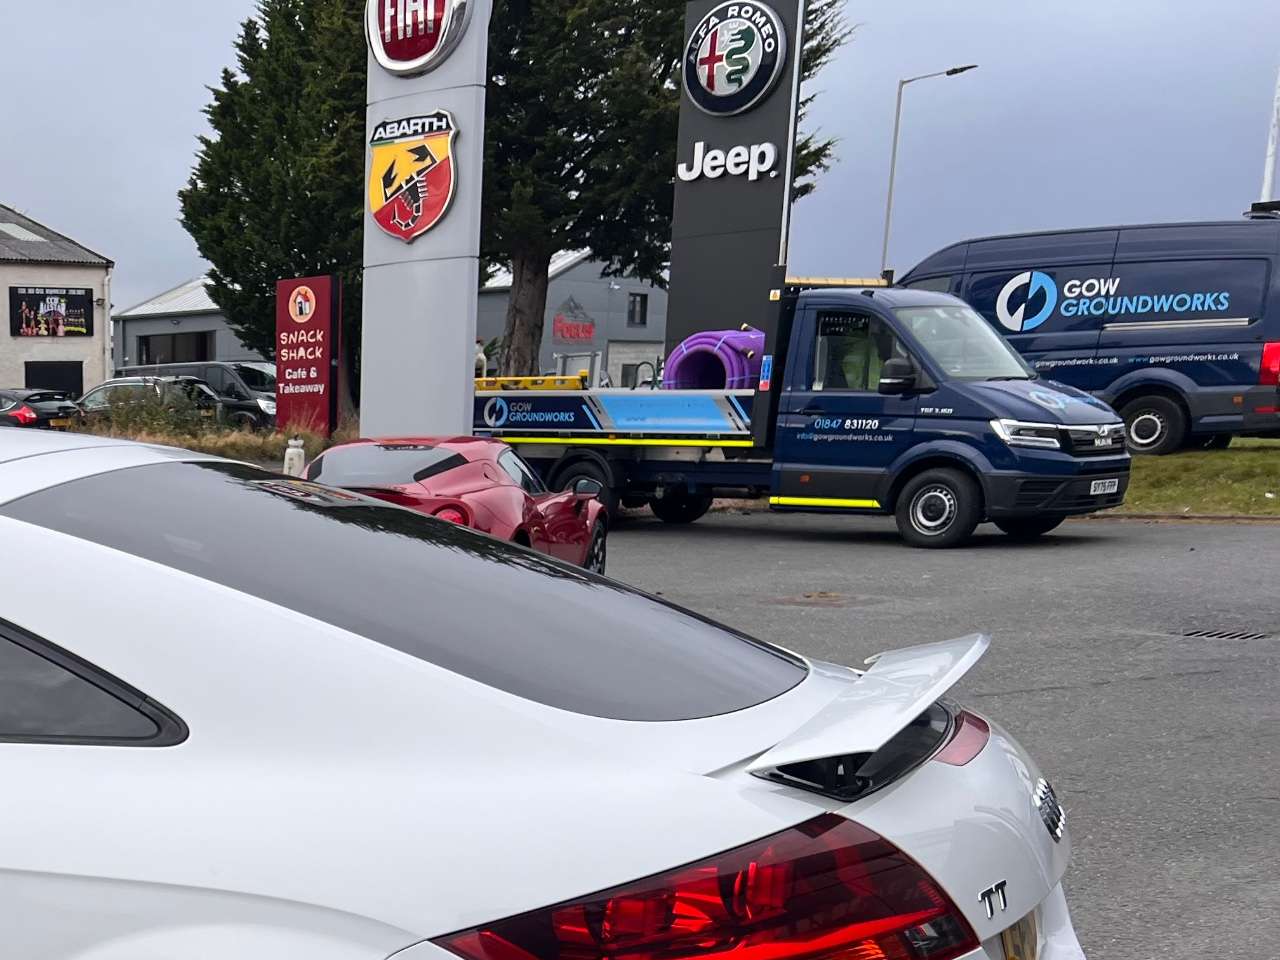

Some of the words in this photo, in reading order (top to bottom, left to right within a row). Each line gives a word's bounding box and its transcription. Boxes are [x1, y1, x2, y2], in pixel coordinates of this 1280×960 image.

[384, 0, 436, 42] FIAT
[689, 15, 720, 63] ALFA
[727, 5, 775, 53] ROMEO
[373, 116, 447, 141] ABARTH
[677, 141, 777, 181] Jeep
[1064, 277, 1120, 297] GOW
[1060, 291, 1230, 317] GROUNDWORKS
[280, 329, 324, 345] SNACK
[280, 346, 323, 361] SHACK
[285, 368, 307, 379] Café
[309, 367, 318, 378] &
[278, 383, 325, 395] Takeaway
[509, 402, 532, 412] GOW
[509, 411, 575, 422] GROUNDWORKS
[814, 419, 842, 430] 01847
[844, 419, 879, 430] 831120
[978, 879, 1007, 920] TT
